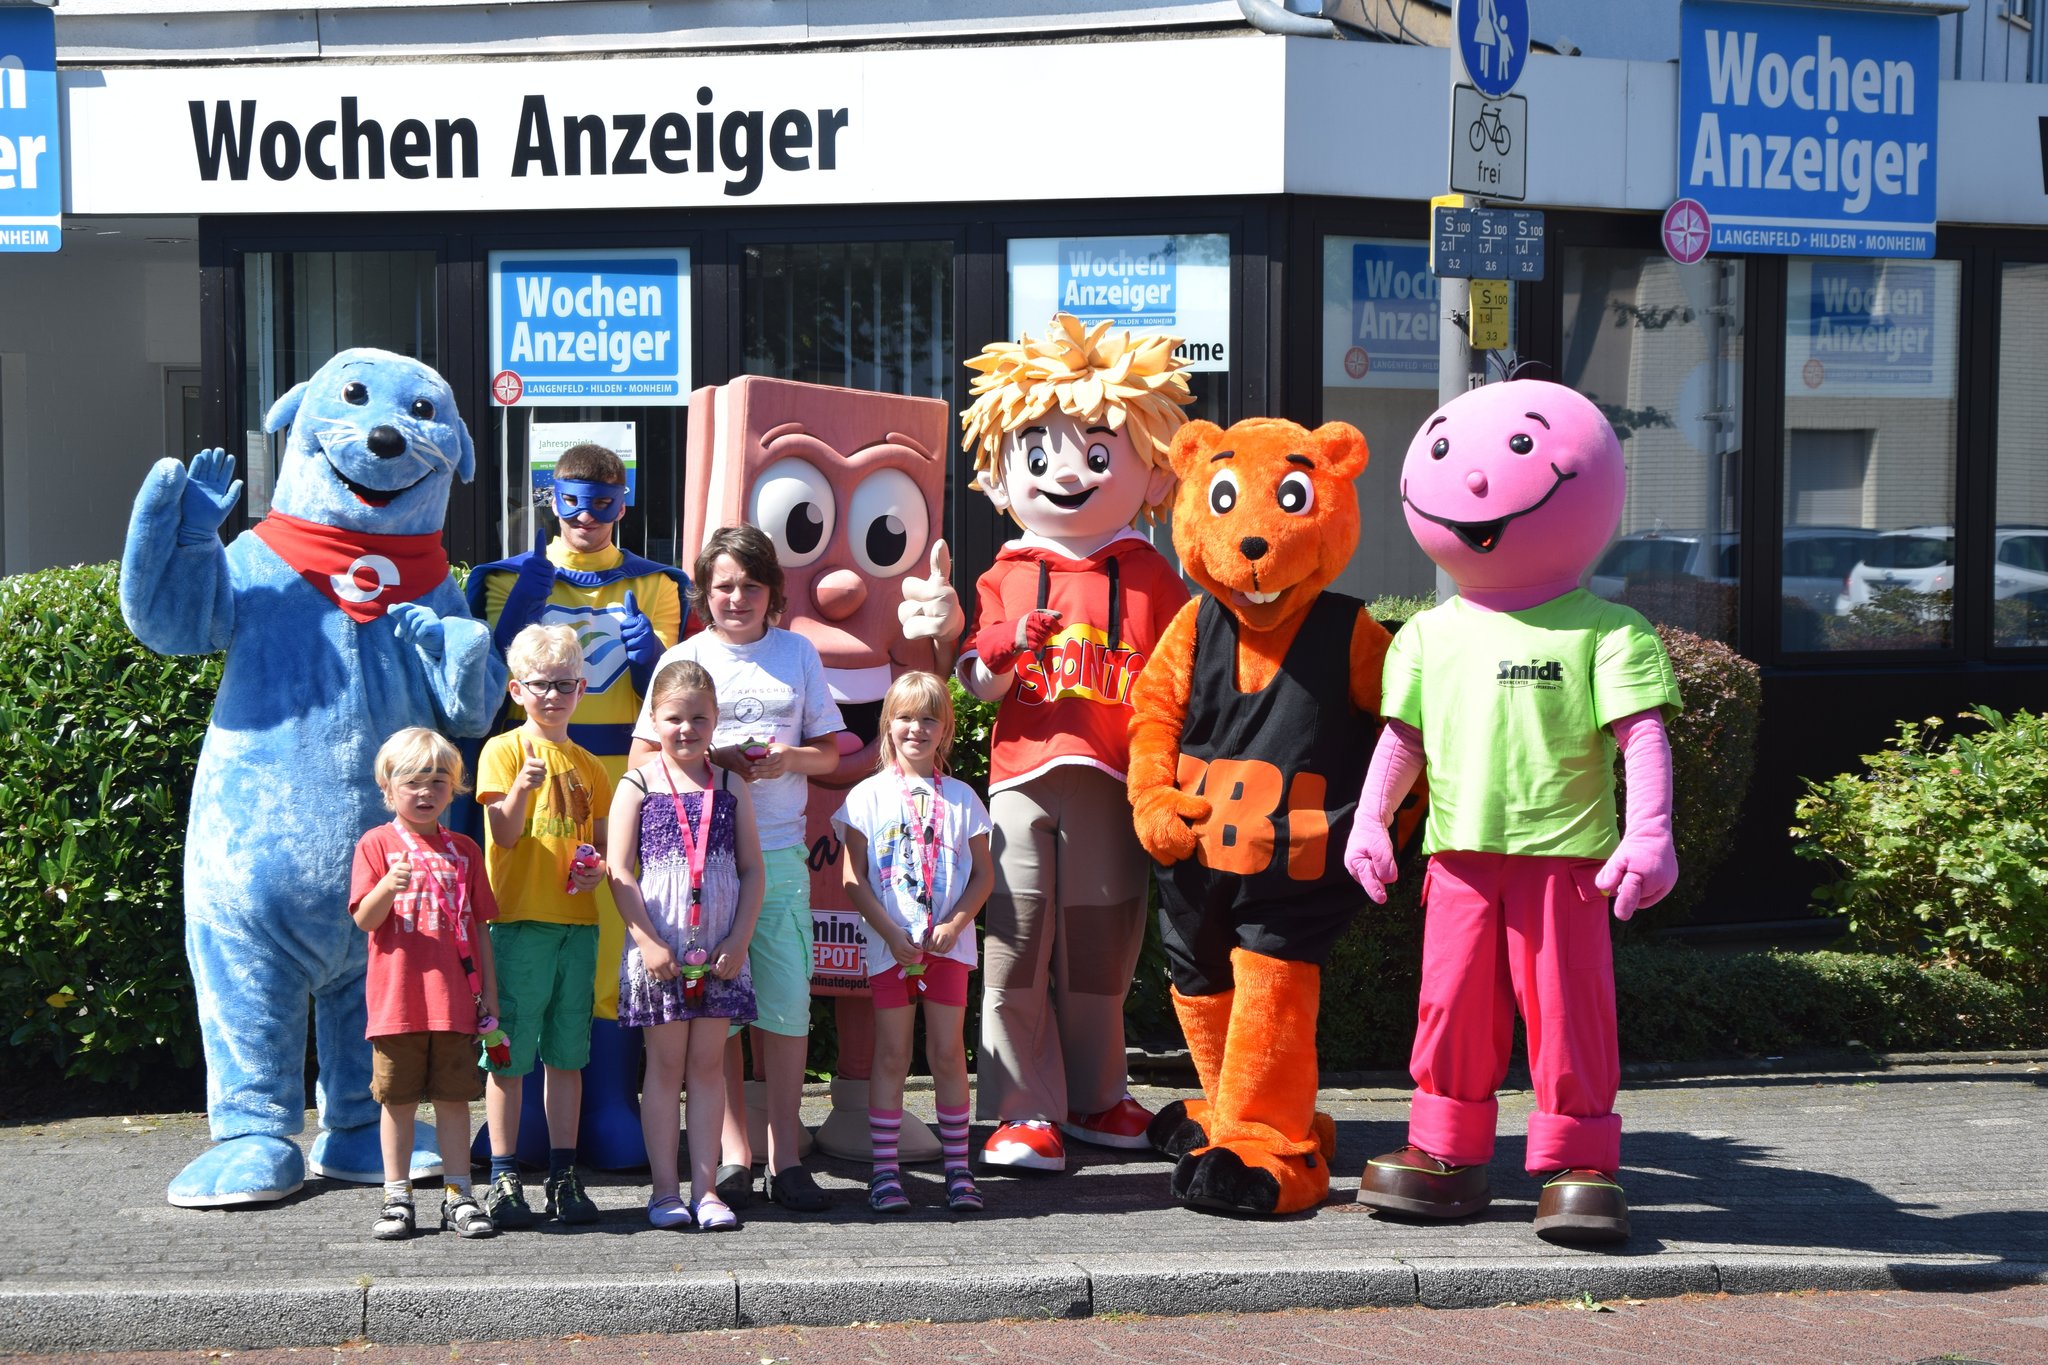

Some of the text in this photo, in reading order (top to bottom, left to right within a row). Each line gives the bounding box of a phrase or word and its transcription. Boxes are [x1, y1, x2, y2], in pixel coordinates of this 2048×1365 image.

[1705, 29, 1915, 115] Wochen
[188, 86, 849, 197] Wochen Anzeiger
[1478, 160, 1501, 185] frei
[1690, 112, 1928, 214] Anzeiger
[1445, 216, 1471, 233] S 100
[1482, 219, 1507, 235] S 100
[1518, 220, 1544, 236] S 100
[1717, 229, 1926, 252] LANGENFELD HILDEN MONHEIM
[1068, 248, 1166, 278] Wochen
[1064, 278, 1172, 312] Anzeiger
[1365, 259, 1441, 300] Woch
[516, 275, 662, 318] Wochen
[1482, 289, 1508, 305] S 100
[1360, 302, 1441, 341] Anzei
[509, 319, 671, 373] Anzeiger
[1816, 316, 1929, 363] Anzeiger
[528, 384, 672, 393] LANGENFELD HILDEN MONHEIM
[1496, 659, 1564, 681] Smidt
